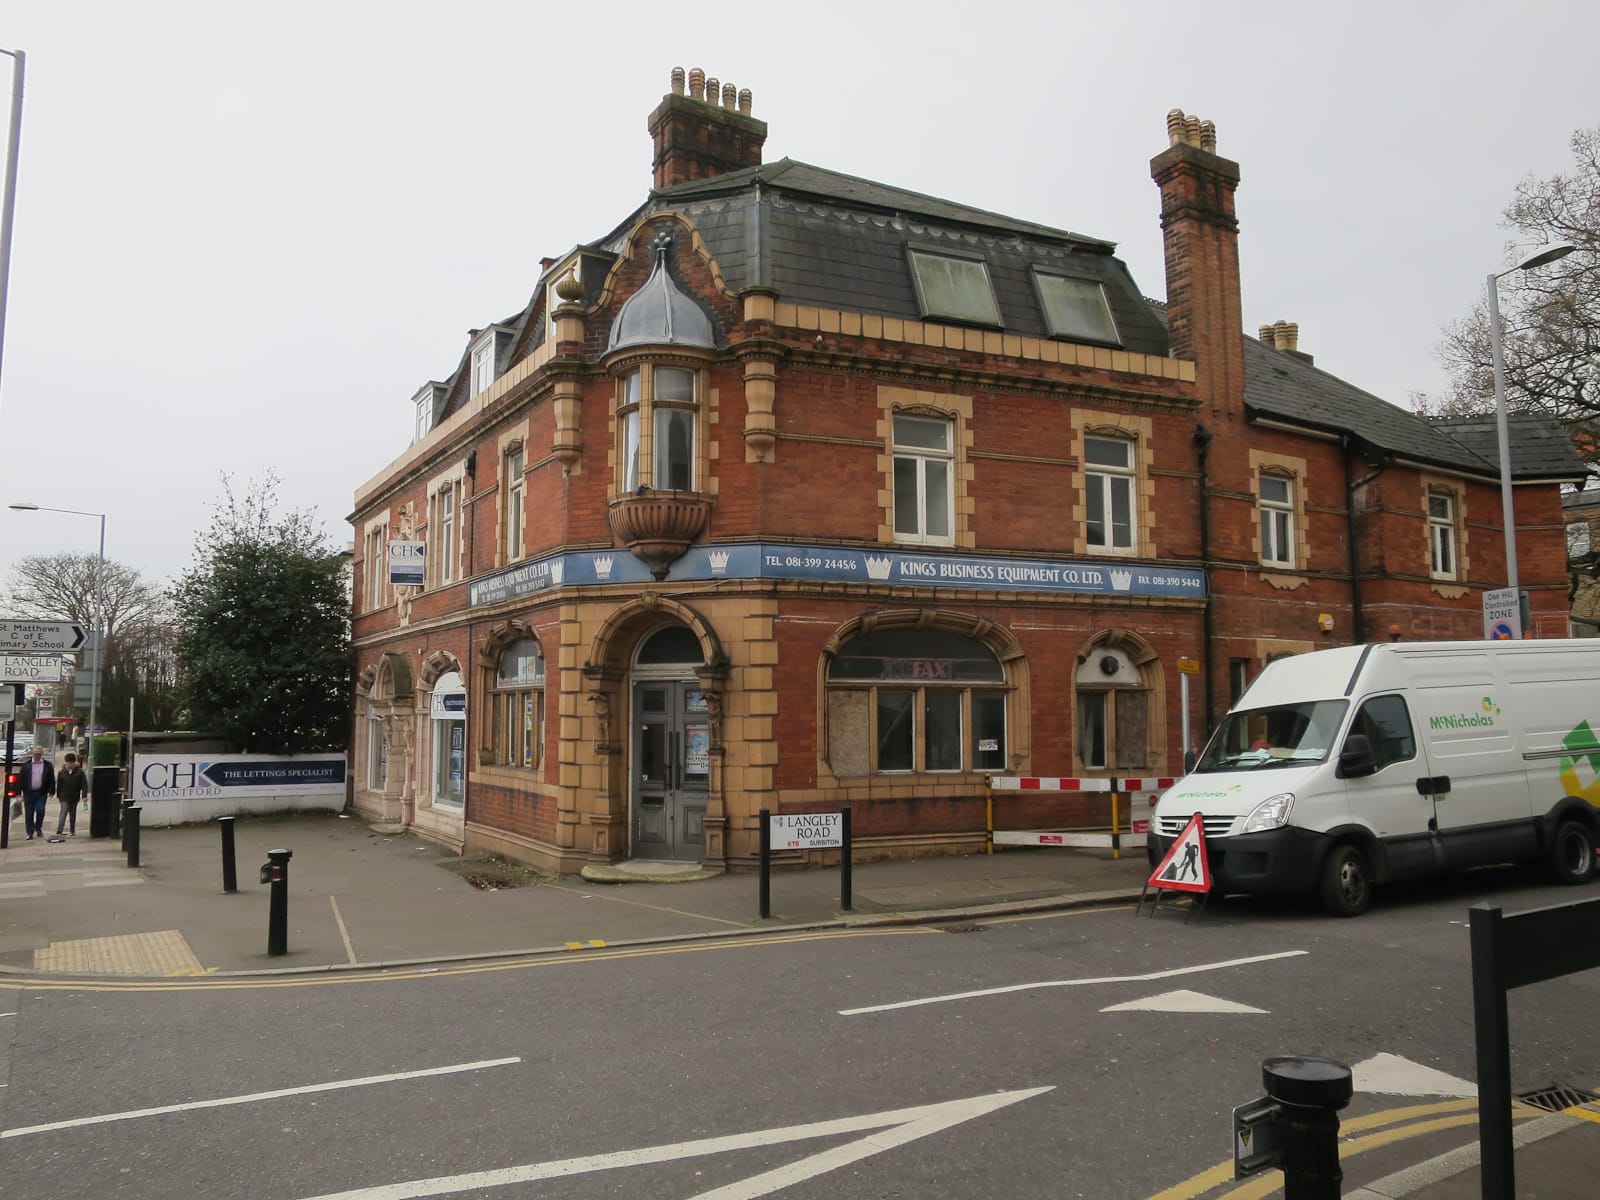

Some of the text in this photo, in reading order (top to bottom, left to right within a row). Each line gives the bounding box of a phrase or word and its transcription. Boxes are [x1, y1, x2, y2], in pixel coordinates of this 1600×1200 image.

[786, 556, 822, 568] 081-399
[825, 559, 857, 570] 2445/6
[900, 561, 1104, 584] KINGS BUSINESS EQUIPMENT CO. LTD.
[1152, 576, 1180, 586] 081-390
[1182, 578, 1201, 587] 5442
[1490, 609, 1513, 620] ZONE
[14, 624, 60, 633] Matthews
[32, 641, 65, 649] School
[5, 657, 58, 667] LANGLEY
[5, 667, 40, 677] ROAD
[1430, 713, 1494, 730] McNicholas
[224, 768, 334, 778] THE LETTINGS SPECIALIST
[141, 787, 222, 798] MOUNTFORD
[788, 816, 839, 828] LANGLEY
[797, 827, 830, 839] ROAD
[809, 839, 840, 847] SURBITON
